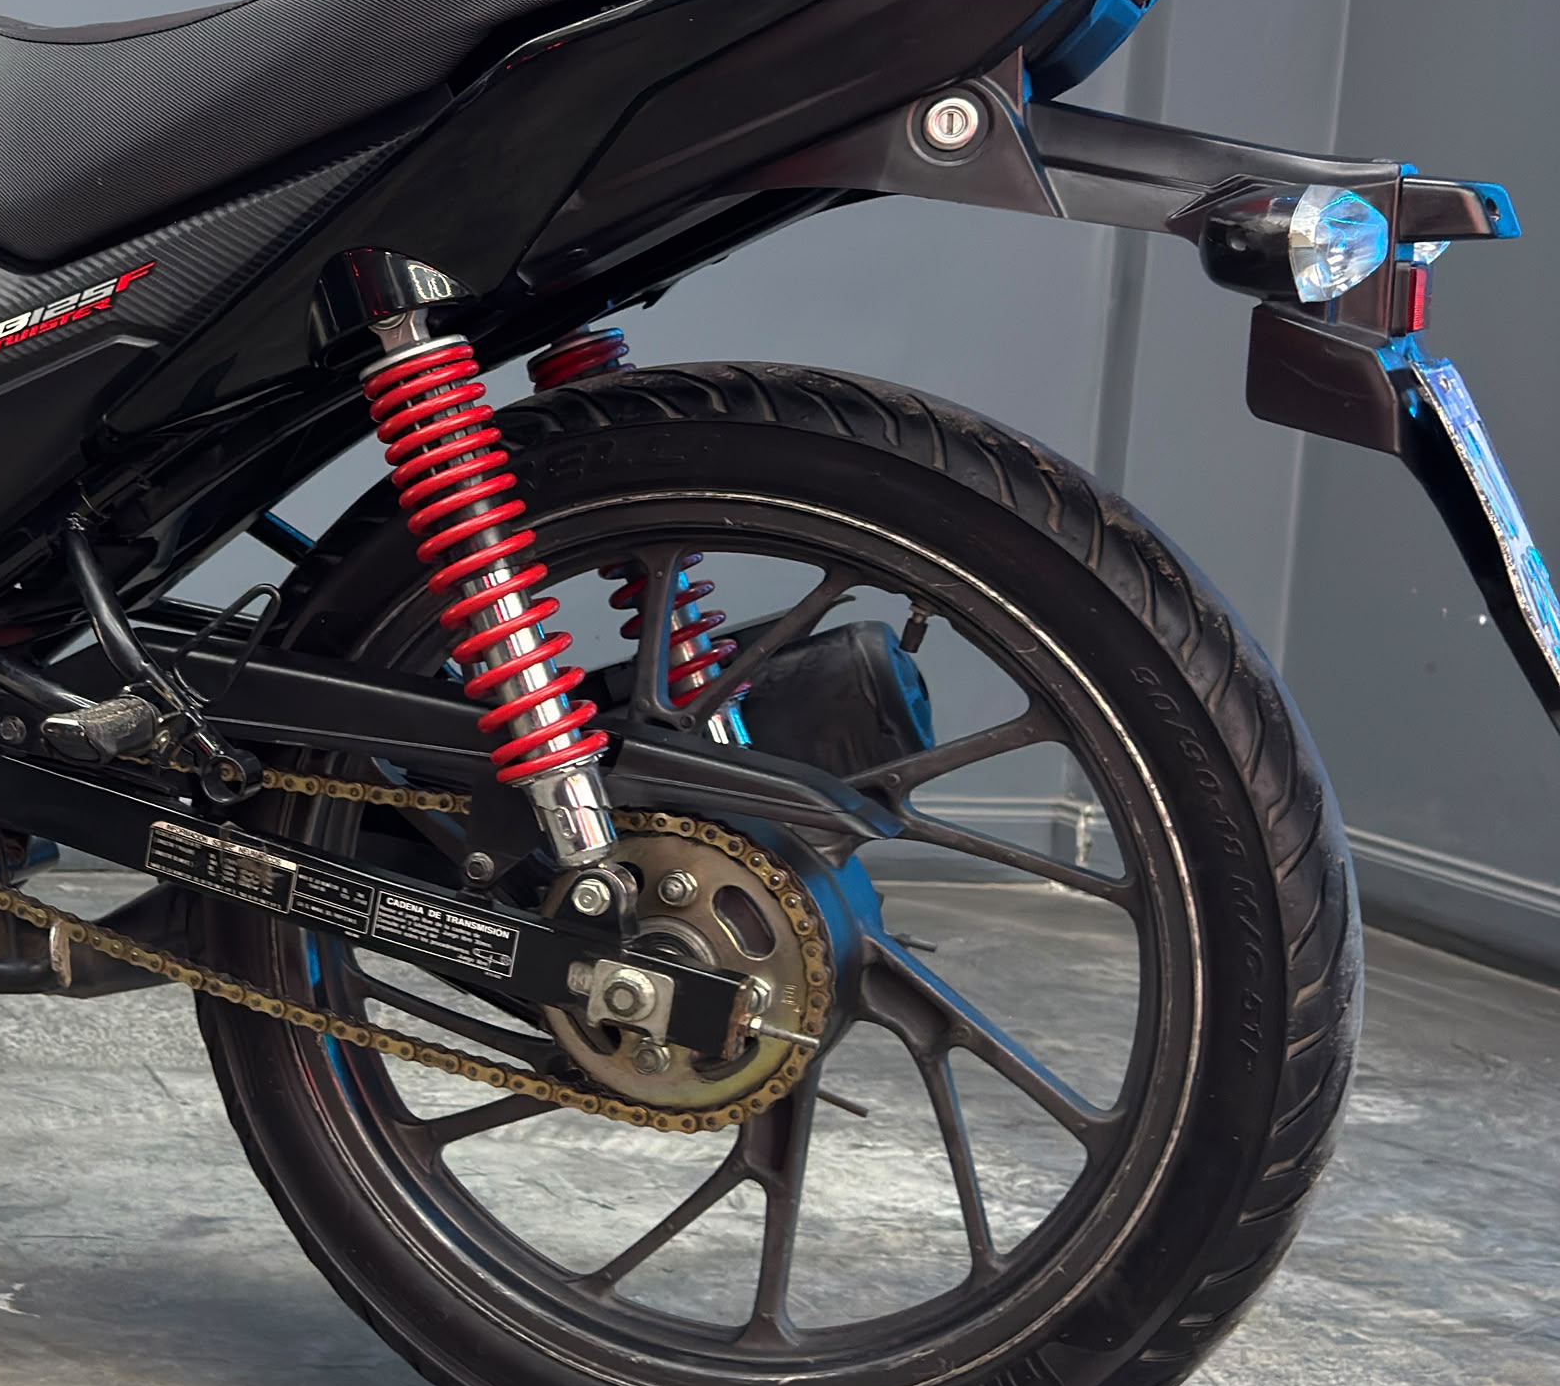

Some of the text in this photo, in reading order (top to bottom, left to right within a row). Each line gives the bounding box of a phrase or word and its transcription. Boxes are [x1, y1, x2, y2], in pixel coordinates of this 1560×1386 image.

[385, 896, 425, 915] CADENA
[427, 908, 443, 921] DE
[445, 913, 511, 940] TRANSMISIÓN
